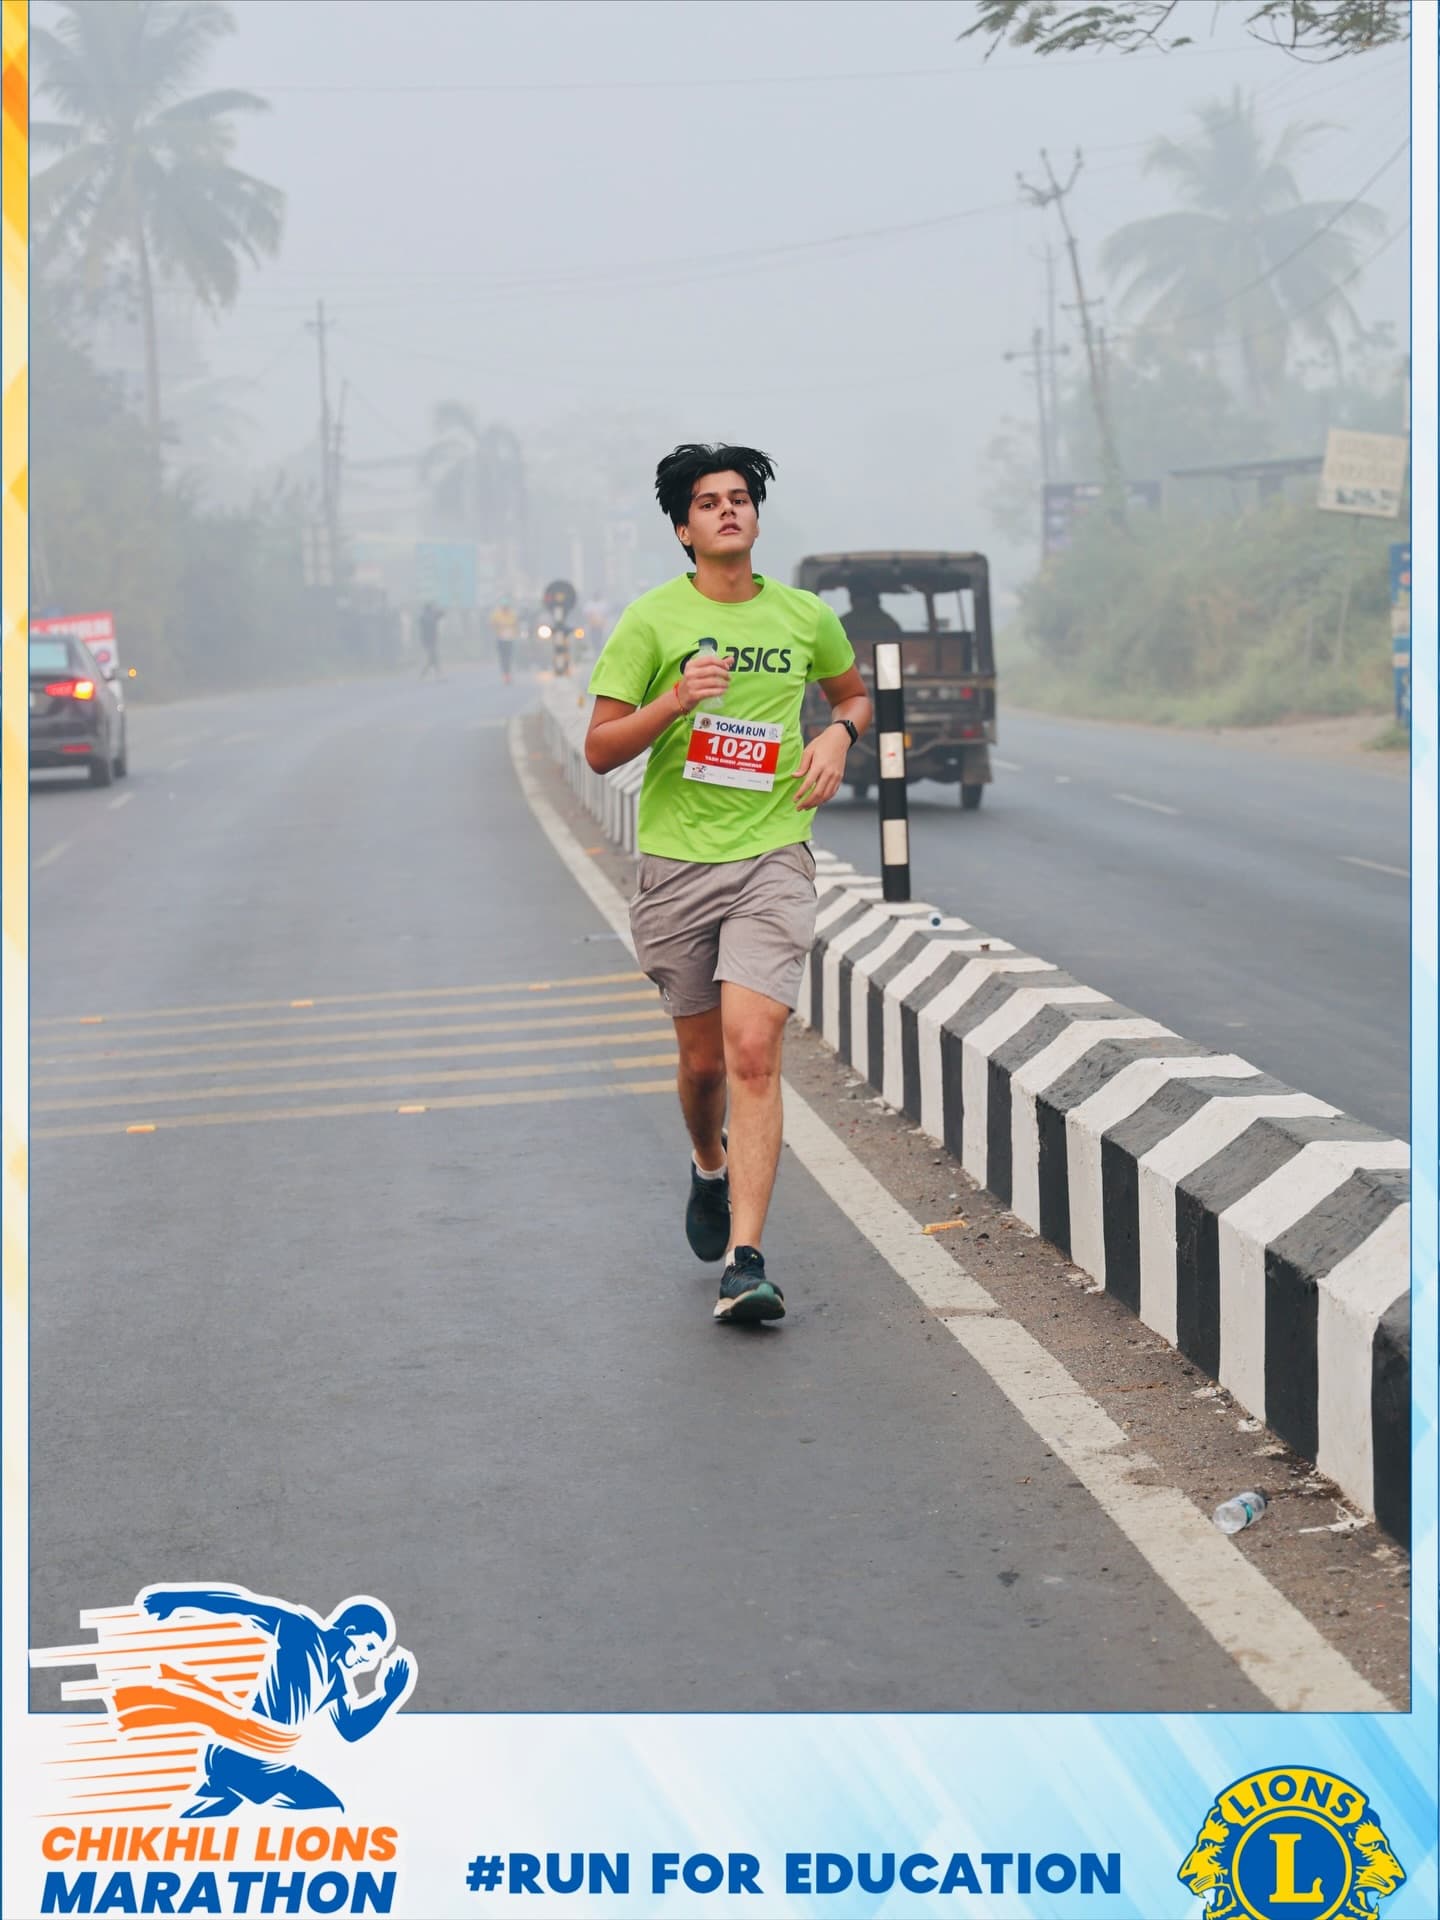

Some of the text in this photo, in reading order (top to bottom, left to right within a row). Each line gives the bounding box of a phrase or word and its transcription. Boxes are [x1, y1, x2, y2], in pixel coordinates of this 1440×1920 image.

[716, 721, 766, 737] 10KM RUN
[707, 735, 767, 762] 1020
